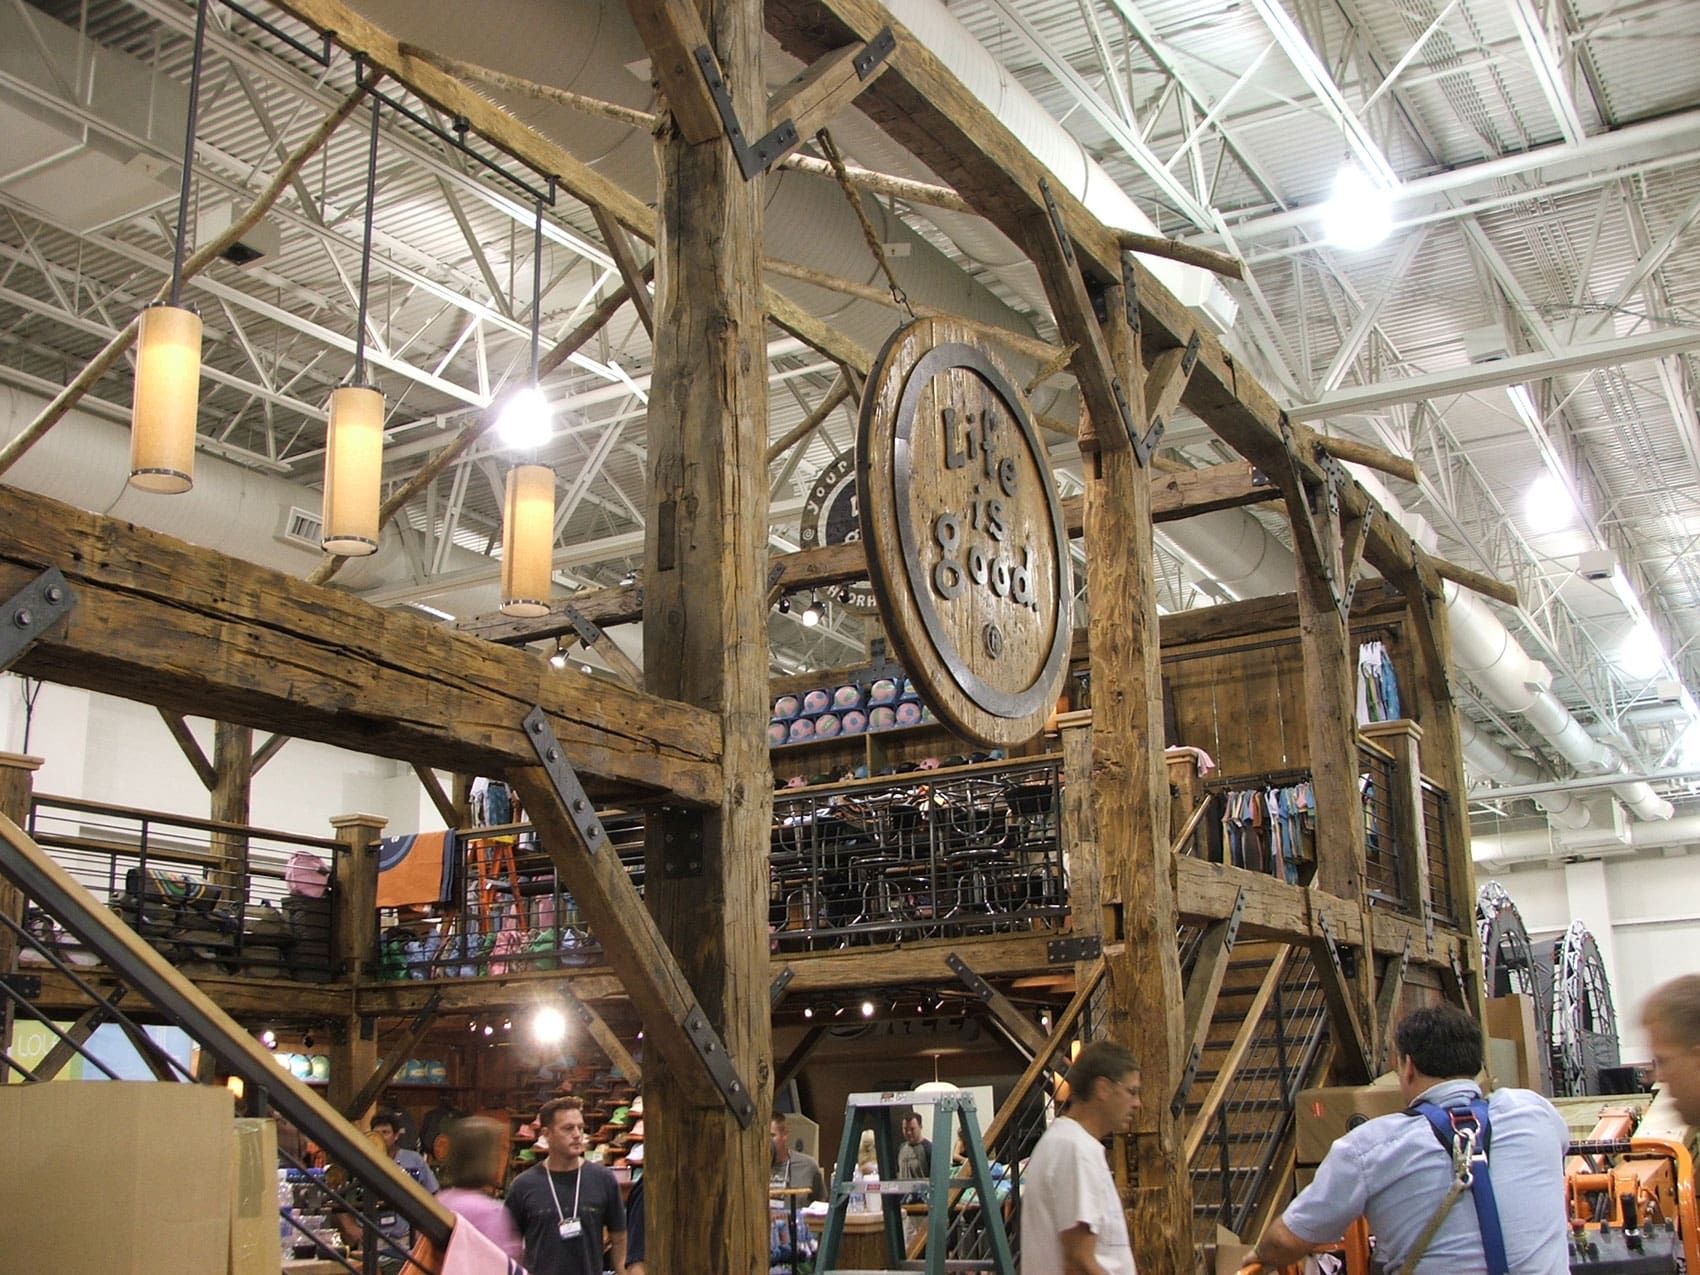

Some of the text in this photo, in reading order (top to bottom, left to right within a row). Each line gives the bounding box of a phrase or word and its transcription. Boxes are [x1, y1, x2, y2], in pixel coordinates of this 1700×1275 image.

[943, 407, 1018, 497] Life
[807, 460, 848, 516] your
[972, 483, 1009, 542] is
